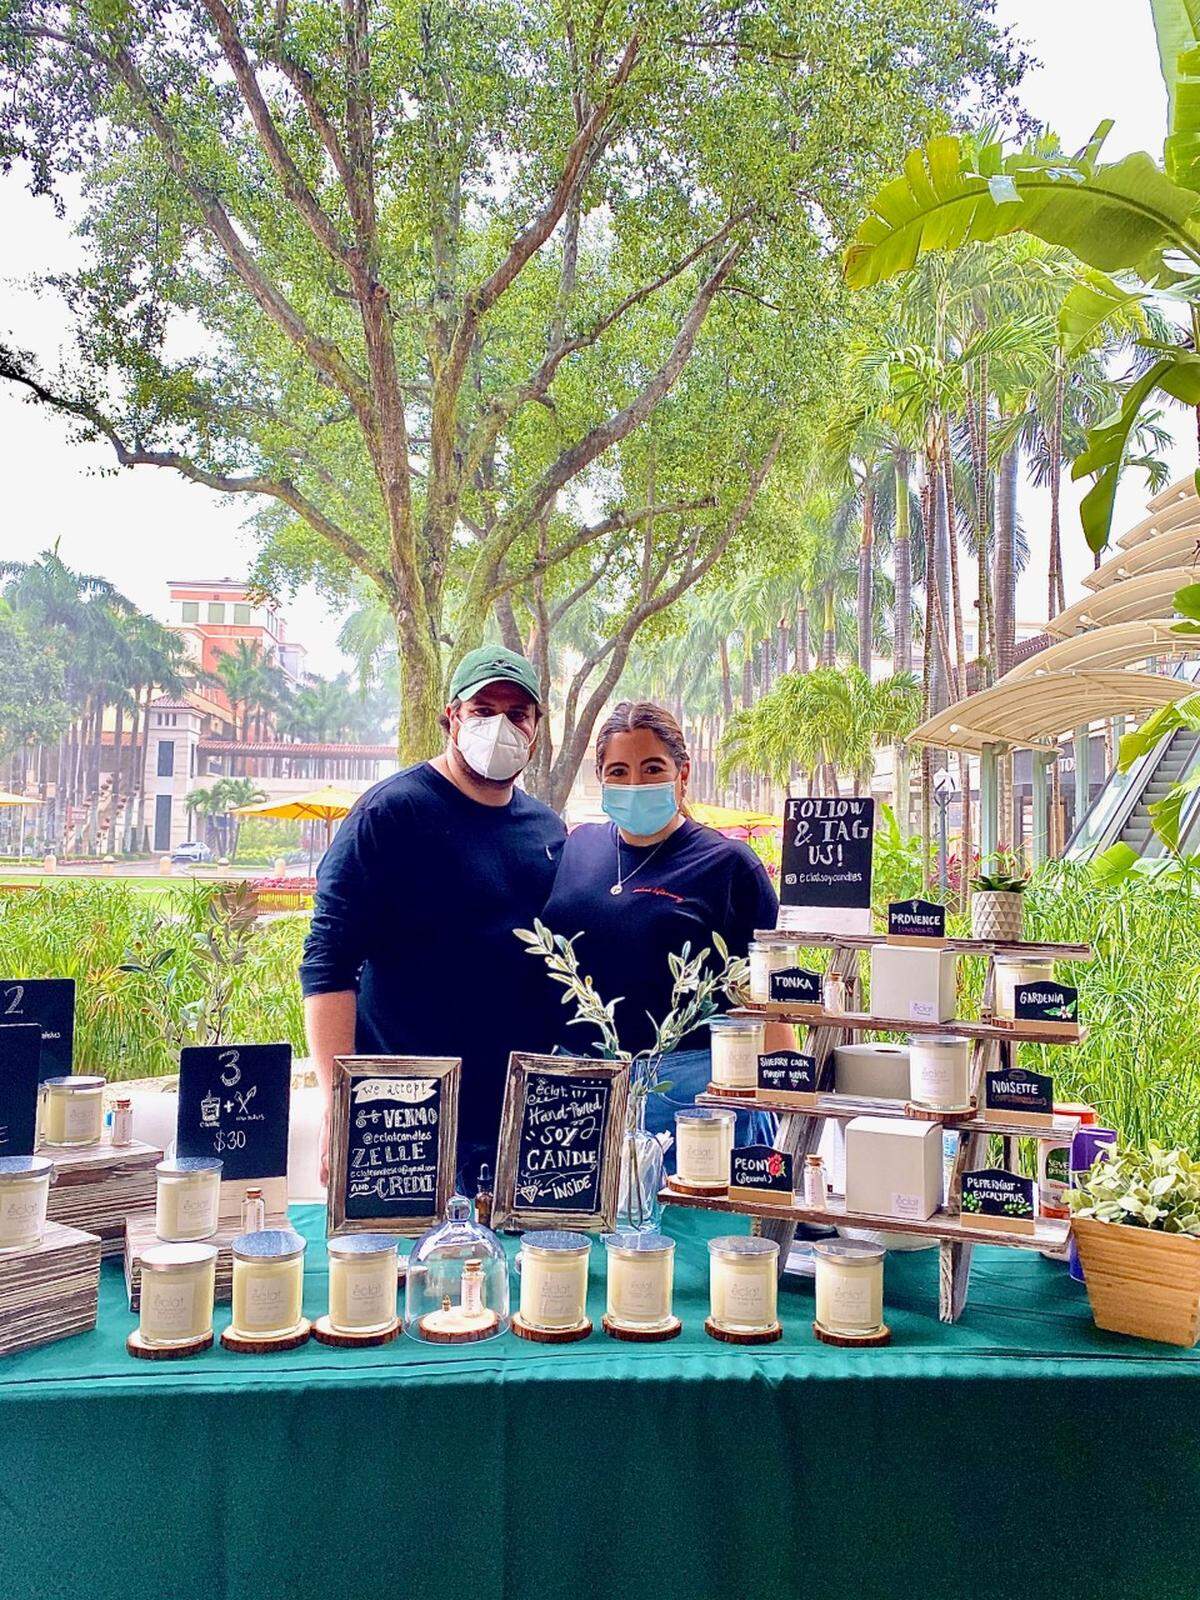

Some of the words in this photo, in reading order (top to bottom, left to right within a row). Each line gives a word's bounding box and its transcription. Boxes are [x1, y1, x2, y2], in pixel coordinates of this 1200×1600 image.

[787, 800, 865, 820] FOLLOW
[794, 821, 813, 847] &
[820, 820, 869, 842] TAG
[809, 844, 843, 867] US!
[891, 912, 941, 926] PROVENCE
[775, 976, 813, 990] TONKA
[4, 985, 24, 1014] 2
[1020, 991, 1064, 1005] GARDENIA
[219, 1050, 241, 1086] 3
[760, 1057, 788, 1067] SHERRY
[992, 1080, 1038, 1095] NOISETTE
[383, 1107, 437, 1128] VENMO
[213, 1130, 246, 1153] $30
[352, 1142, 426, 1168] ZELLE
[527, 1149, 597, 1170] CANDLE
[735, 1157, 769, 1172] PEONY
[351, 1183, 369, 1192] AND
[375, 1175, 434, 1199] CREDIT
[973, 1191, 1025, 1204] EUCALYPTUS
